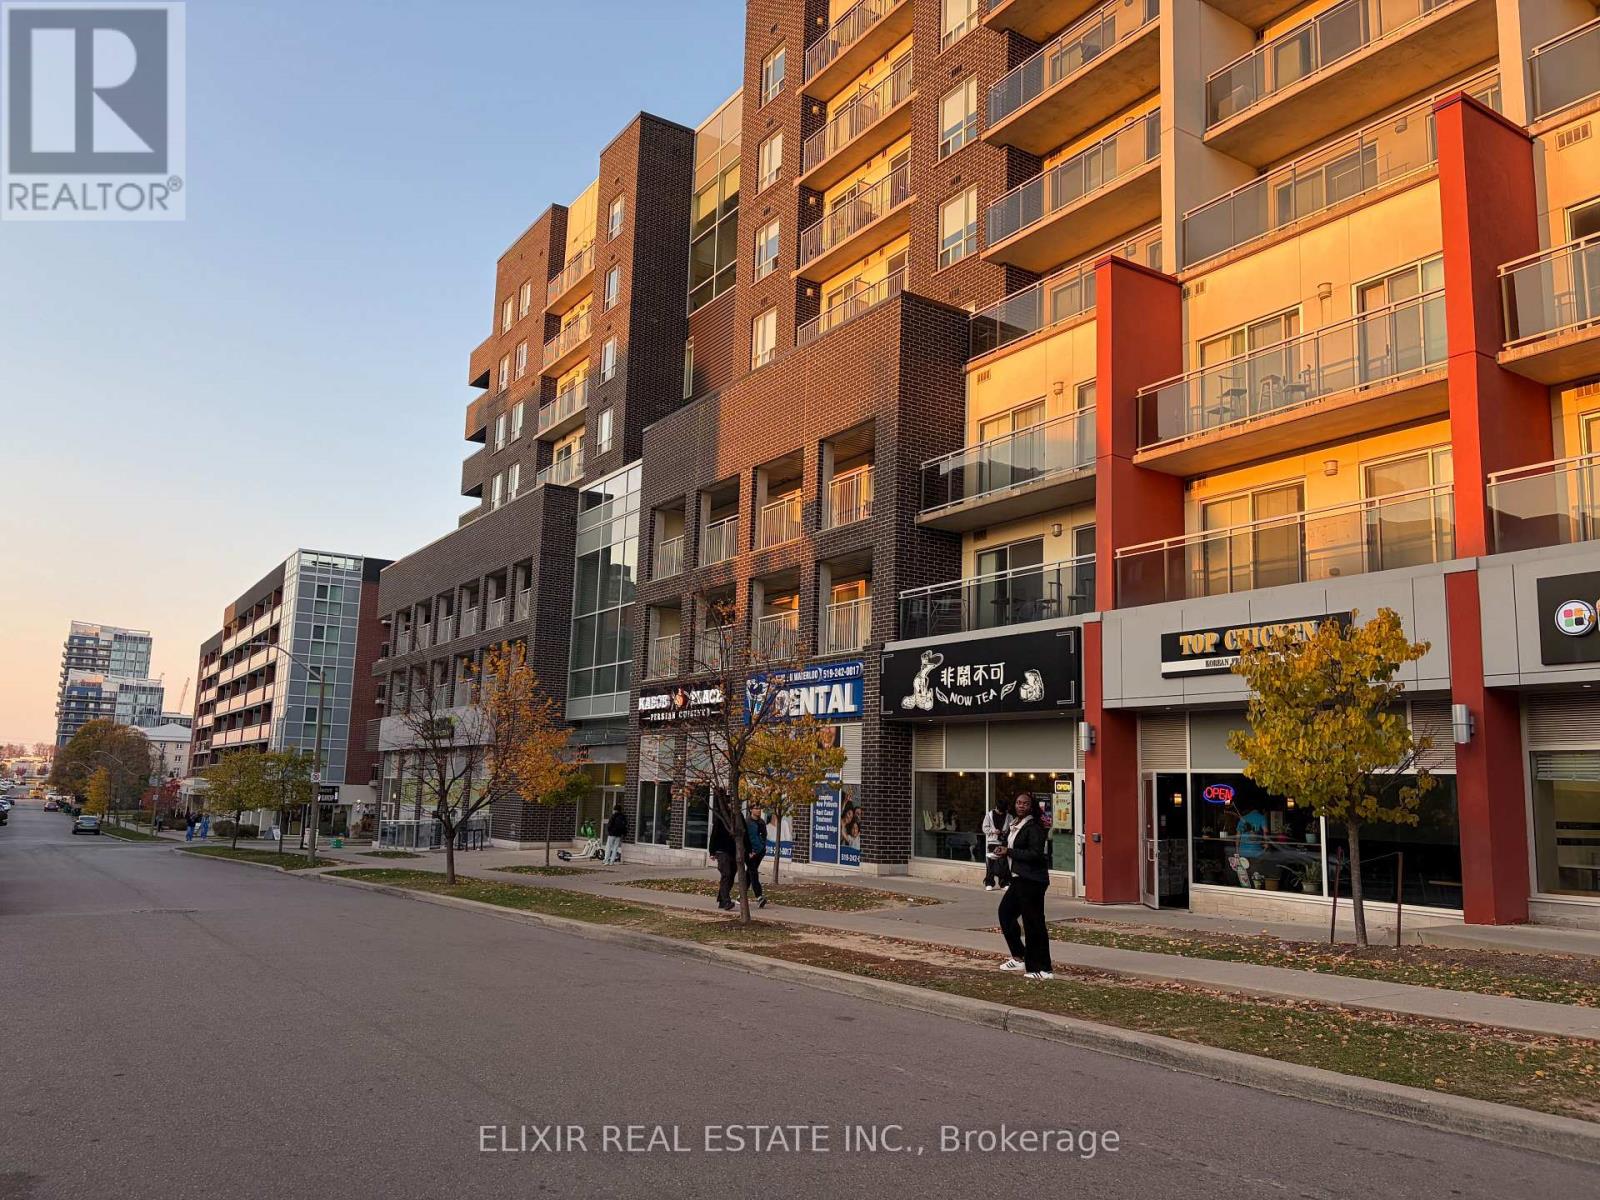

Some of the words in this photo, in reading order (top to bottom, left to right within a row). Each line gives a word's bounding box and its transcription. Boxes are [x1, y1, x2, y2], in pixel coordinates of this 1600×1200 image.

[1179, 632, 1219, 656] TOP
[1205, 657, 1229, 668] KOREAN
[941, 662, 1005, 688] 非鬧不可
[638, 694, 671, 711] KABOB
[949, 691, 973, 706] NOW
[975, 688, 998, 705] TEA
[1205, 786, 1233, 801] OPEN
